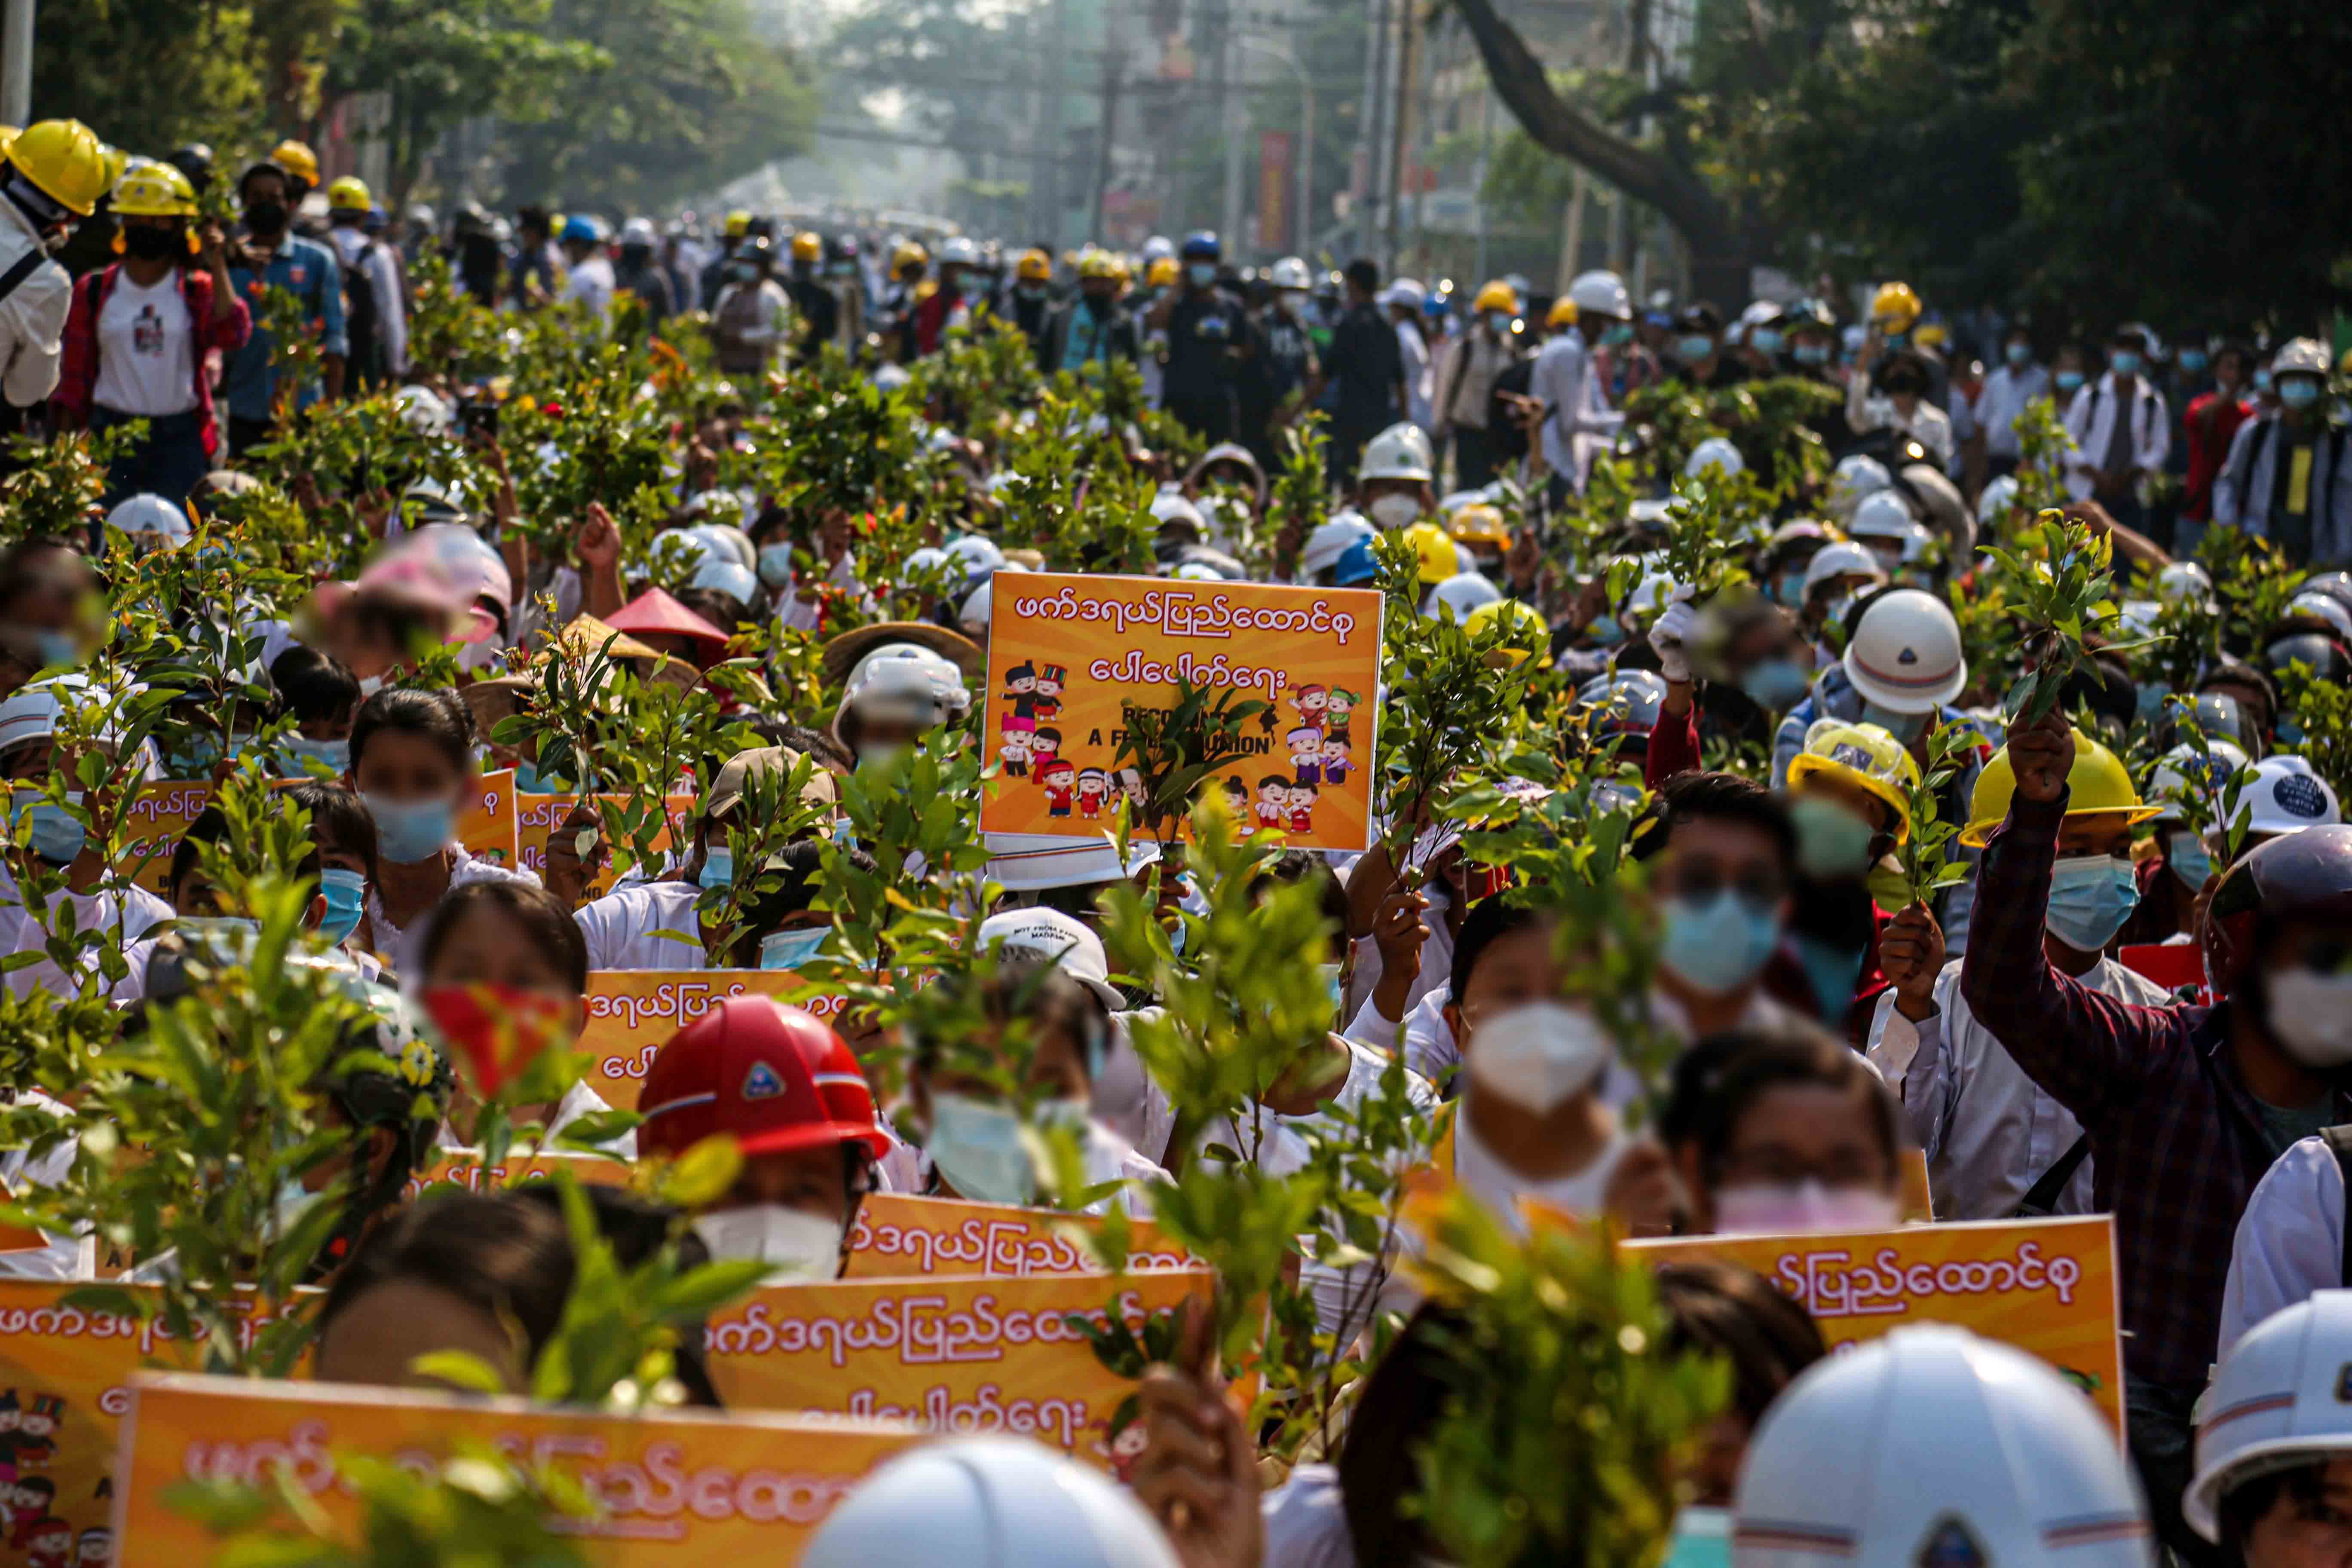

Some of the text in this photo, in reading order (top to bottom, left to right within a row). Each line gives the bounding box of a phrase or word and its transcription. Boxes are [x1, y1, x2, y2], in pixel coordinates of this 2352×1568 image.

[1014, 586, 1356, 646] ဖက်ဒရယ်ပြည်ထောင်စု
[1089, 649, 1287, 701] ပေါ်ပေါက်ရေး
[1087, 728, 1102, 746] A
